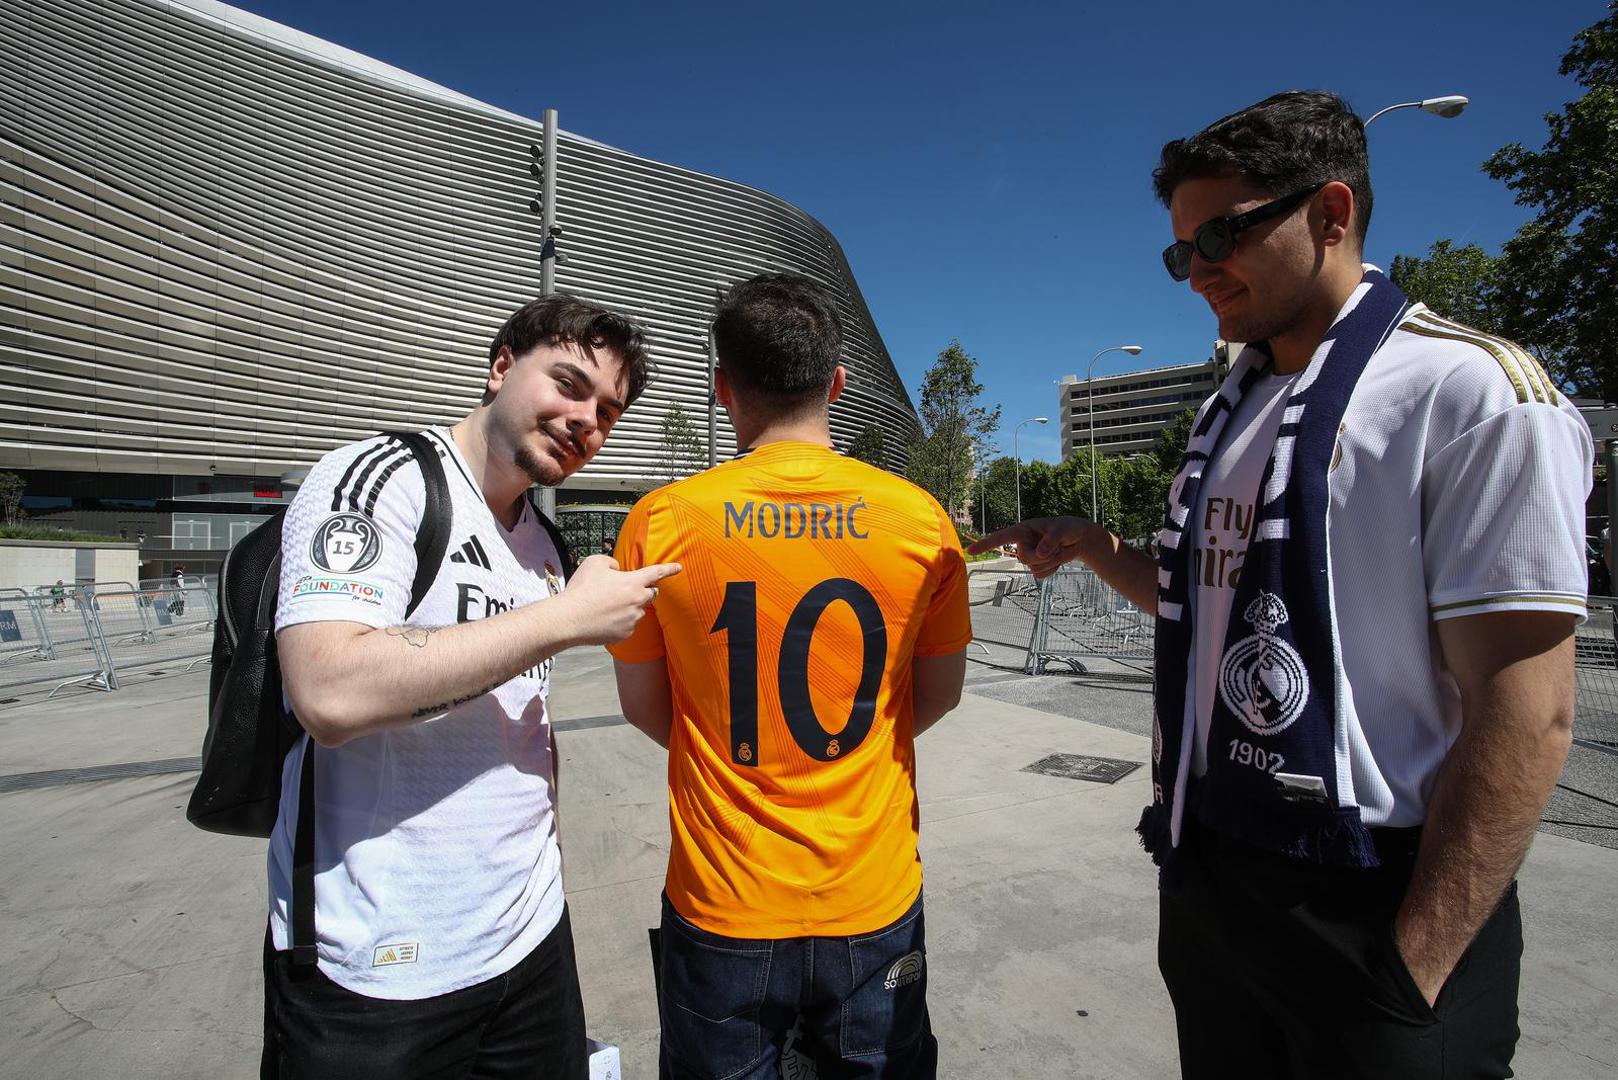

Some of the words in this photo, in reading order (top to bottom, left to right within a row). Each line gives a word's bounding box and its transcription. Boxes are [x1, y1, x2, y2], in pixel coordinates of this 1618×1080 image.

[724, 496, 870, 539] MODRIĆ
[1204, 498, 1253, 540] Fly
[332, 541, 355, 555] 15
[293, 581, 384, 600] FOUNDATION
[709, 577, 888, 767] 10
[1229, 738, 1286, 775] 1902
